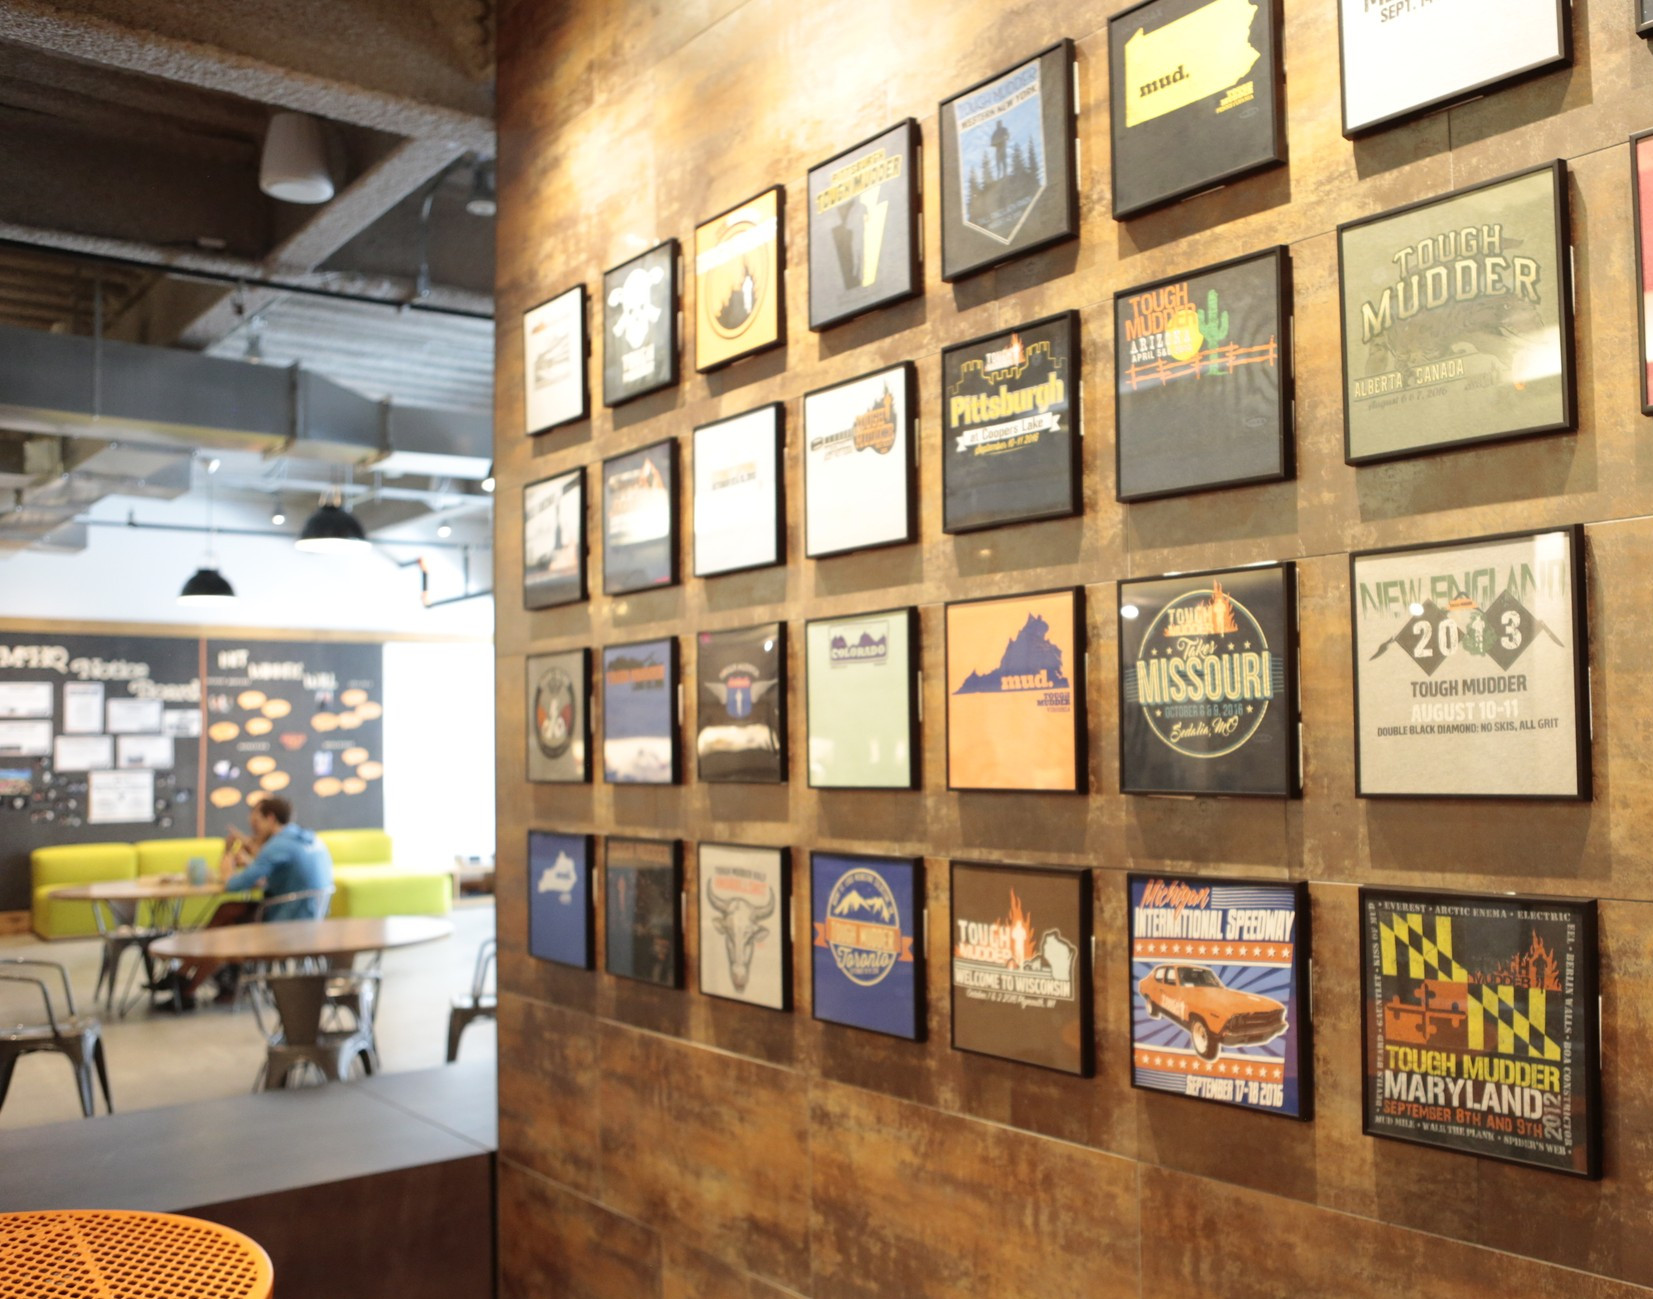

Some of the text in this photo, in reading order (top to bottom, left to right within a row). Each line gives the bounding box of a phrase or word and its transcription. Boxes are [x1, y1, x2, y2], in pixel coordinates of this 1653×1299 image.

[1139, 64, 1190, 98] mud.
[1391, 222, 1502, 279] TOUGH
[1128, 281, 1189, 318] TOUGH
[1360, 255, 1542, 345] MUDDER
[1124, 302, 1198, 341] MUDDER
[1131, 350, 1155, 363] APRIL
[950, 371, 1065, 428] Pittsburgh
[1354, 372, 1403, 398] ALBERTA
[982, 423, 1019, 441] Coopers
[1021, 416, 1044, 432] Lake
[1359, 577, 1422, 620] NEW
[1167, 604, 1213, 626] TOUGH
[831, 644, 886, 659] COLORADO
[1176, 636, 1218, 661] Takes
[1001, 668, 1055, 691] mud.
[1136, 650, 1274, 705] MISSOURI
[1410, 674, 1528, 699] TOUGH MUDDER
[1165, 704, 1198, 718] OCTOBER
[1222, 702, 1244, 716] 2016
[1411, 698, 1520, 723] AUGUST 10-11
[1170, 714, 1240, 743] Sedalia, MO
[1377, 717, 1560, 738] DOUBLE BLACK DIAMOND: NO SKIS, ALL GRIT
[1140, 878, 1211, 922] Michigan
[1368, 902, 1378, 925] MUD
[1384, 901, 1571, 922] EVEREST ARCTIC ENEMA ELECTRIC
[957, 918, 1011, 949] TOUGH
[1134, 906, 1296, 942] INTERNATIONAL SPEEDWAY
[1370, 926, 1379, 941] OF
[836, 946, 890, 970] Toronto
[1372, 942, 1381, 966] KISS
[954, 969, 1071, 997] WELCOME TO WISCONSIN
[1374, 974, 1383, 1026] GAUNTLET
[1563, 923, 1576, 1147] EEL BERLIN WALLS BOA CONSTRICTOR
[1385, 1044, 1561, 1093] TOUGH MUDDER
[1185, 1074, 1284, 1108] SEPTEMBER 17-18 2016
[1384, 1069, 1544, 1120] MARYLAND
[1383, 1099, 1544, 1139] SEPTEMBER 8TH AND 9TH
[1541, 1092, 1564, 1142] 2012
[1374, 1114, 1567, 1156] MUD MILE WALK THE PLANK SPIDER'S WEB
